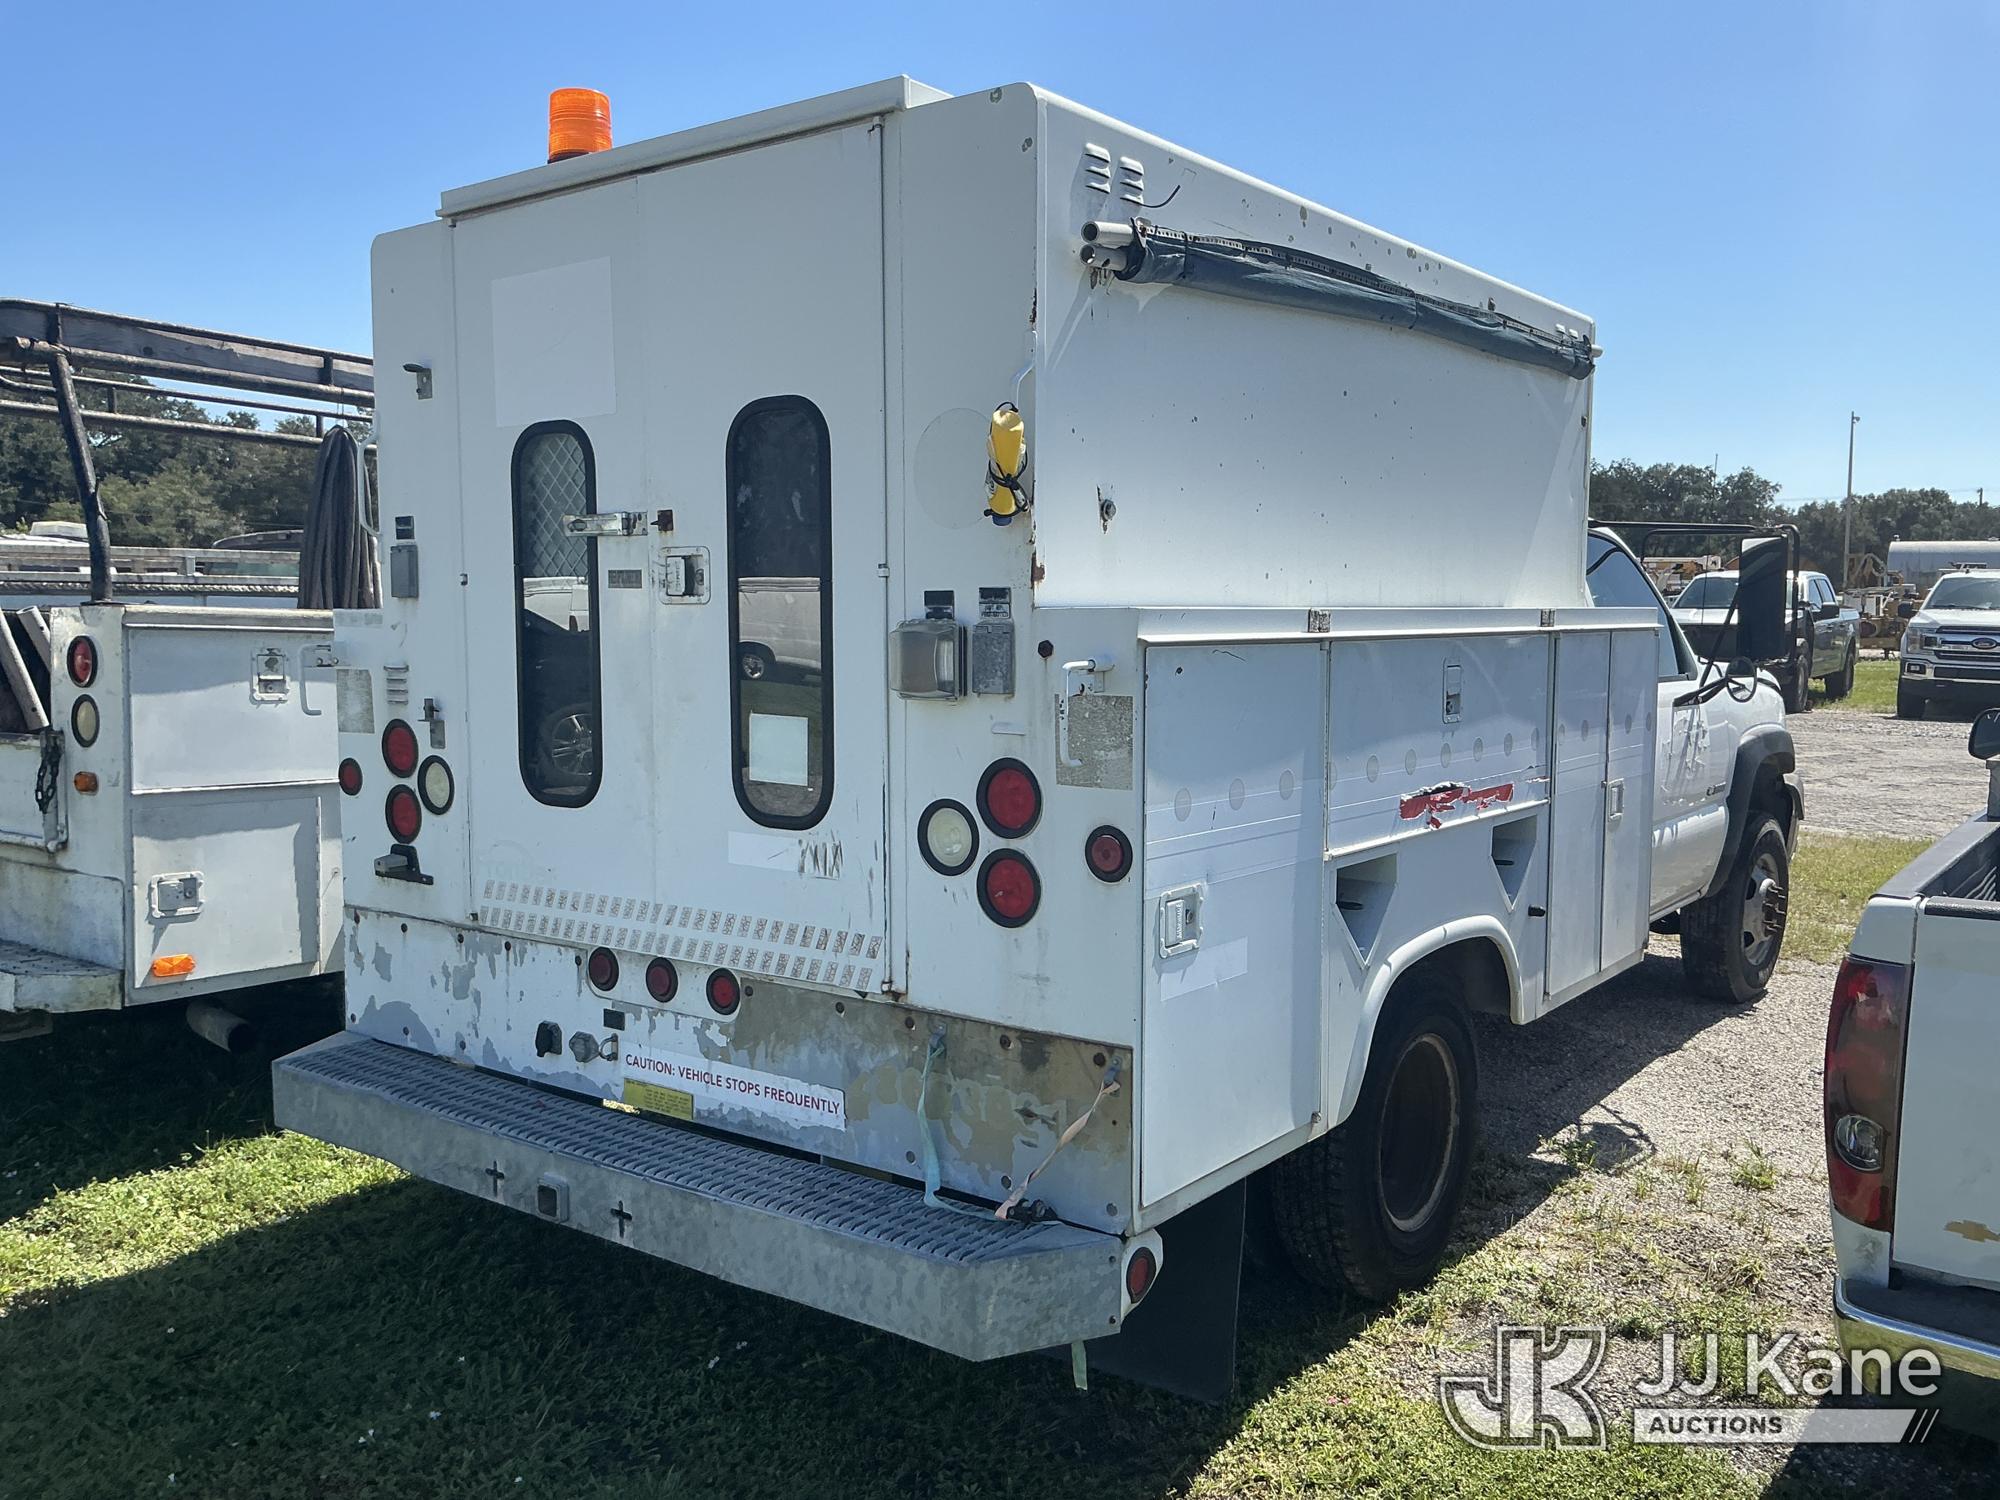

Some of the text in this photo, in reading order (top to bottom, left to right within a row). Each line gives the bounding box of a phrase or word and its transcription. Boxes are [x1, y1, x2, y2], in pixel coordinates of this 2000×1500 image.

[625, 1054, 840, 1115] CAUTION: VEHICLE STOPS FREQUENTLY
